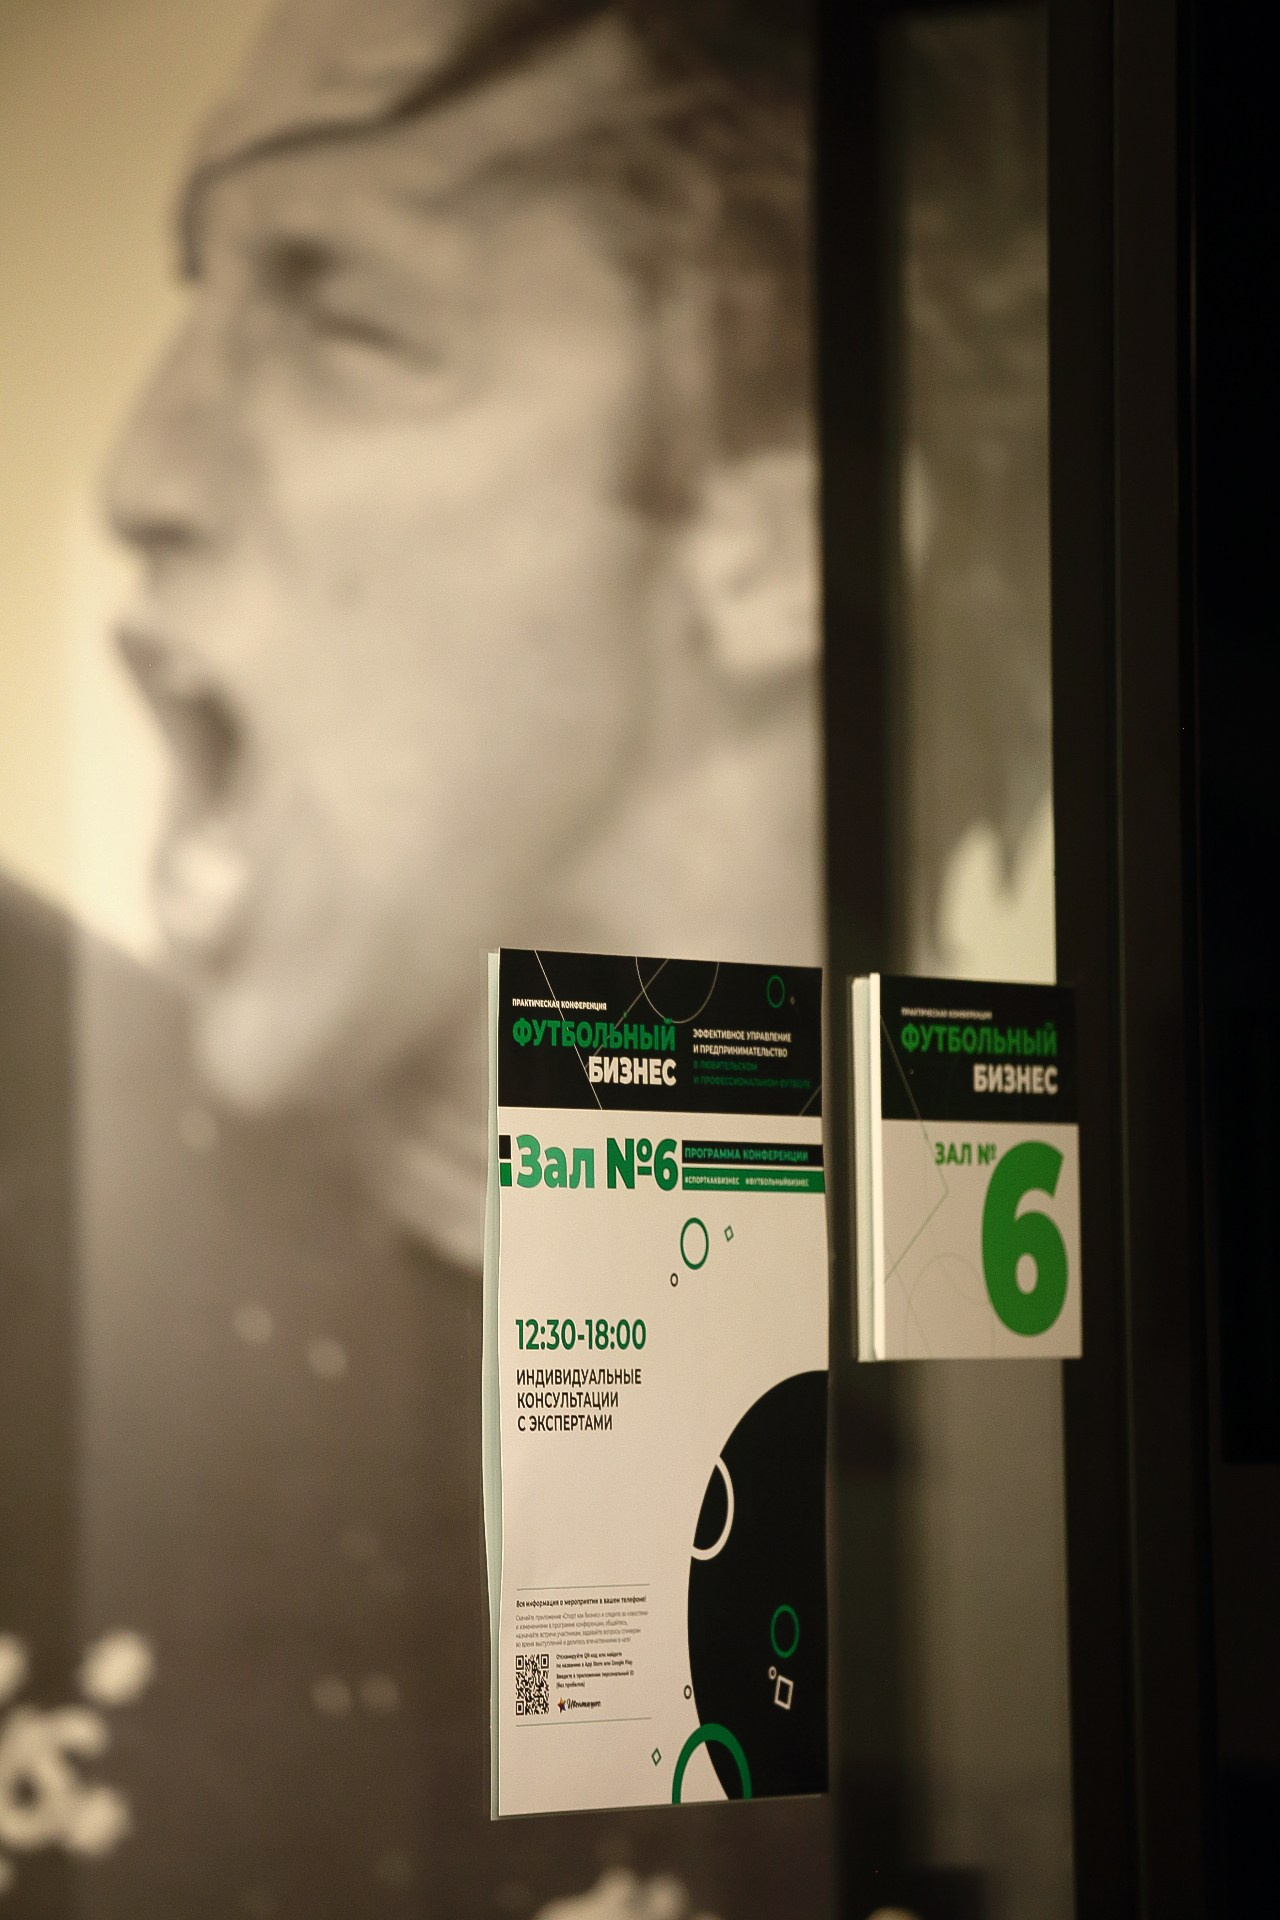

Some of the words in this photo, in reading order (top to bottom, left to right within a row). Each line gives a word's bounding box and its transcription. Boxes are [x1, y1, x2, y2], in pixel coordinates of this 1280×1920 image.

[512, 998, 559, 1008] ПРАКТИЧЕСКАЯ
[560, 1000, 607, 1011] КОНФЕРЕНЦИЯ
[512, 1017, 676, 1051] ФУТБОЛЬНЫЙ
[693, 1028, 745, 1040] ЭФФЕКТИВНОЕ
[747, 1030, 792, 1042] УПРАВЛЕНИЕ
[901, 1022, 1057, 1056] ФУТБОЛЬНЫЙ
[693, 1044, 699, 1053] И
[700, 1044, 788, 1058] ПРЕДПРИНИМАТЕЛЬСТВО
[588, 1055, 677, 1086] БИЗНЕС
[973, 1063, 1059, 1095] БИЗНЕС
[516, 1134, 595, 1188] Зал
[684, 1147, 741, 1160] ПРОГРАММА
[743, 1149, 808, 1162] КОНФЕРЕНЦИИ
[935, 1142, 972, 1165] ЗАЛ
[978, 1143, 997, 1165] №
[981, 1139, 1069, 1338] 6
[516, 1318, 647, 1350] 12:30-18:00
[516, 1368, 642, 1388] ИНДИВИДУАЛЬНЫЕ
[517, 1391, 619, 1411] КОНСУЛЬТАЦИИ
[517, 1415, 526, 1432] С
[529, 1414, 613, 1432] ЭКСПЕРТАМИ
[516, 1600, 526, 1608] Вся
[526, 1600, 559, 1608] информация
